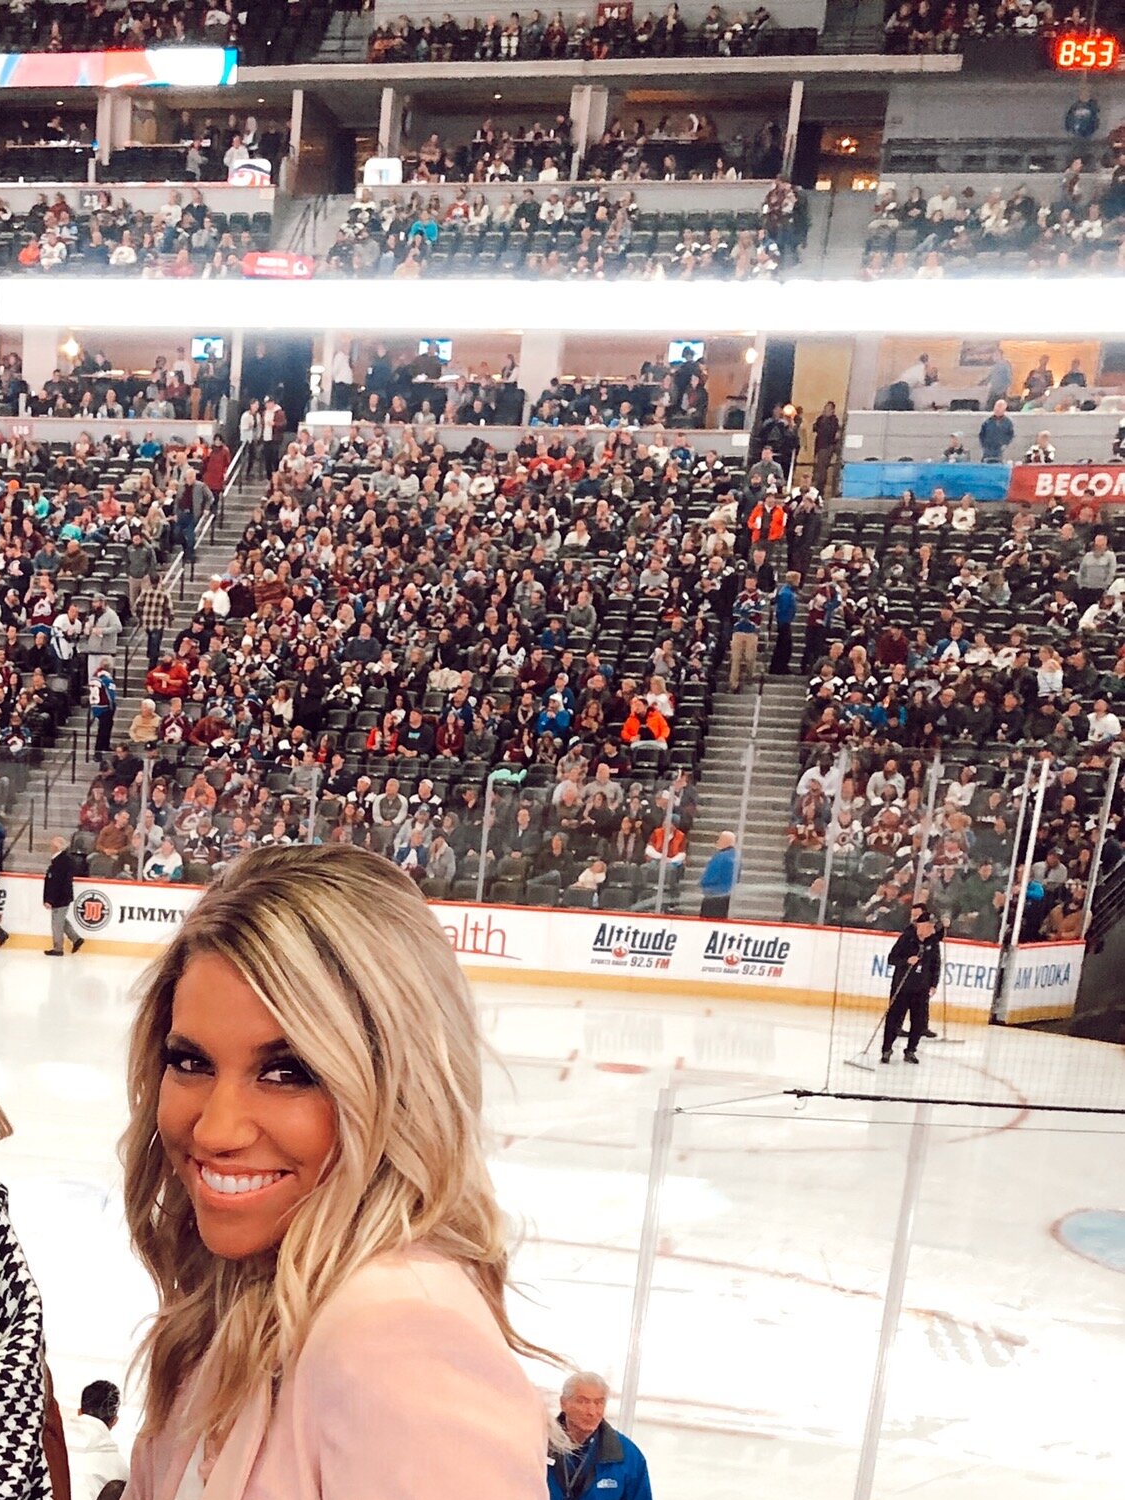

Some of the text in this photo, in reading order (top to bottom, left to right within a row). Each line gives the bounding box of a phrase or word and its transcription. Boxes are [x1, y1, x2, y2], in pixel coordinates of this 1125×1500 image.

[1059, 40, 1114, 66] 8:53
[594, 923, 678, 951] Altitude
[704, 930, 791, 959] Altitude
[630, 956, 653, 968] 92.5
[655, 957, 671, 969] FM
[742, 964, 766, 977] 92.5
[767, 965, 784, 978] FM
[1035, 962, 1071, 988] VODKA
